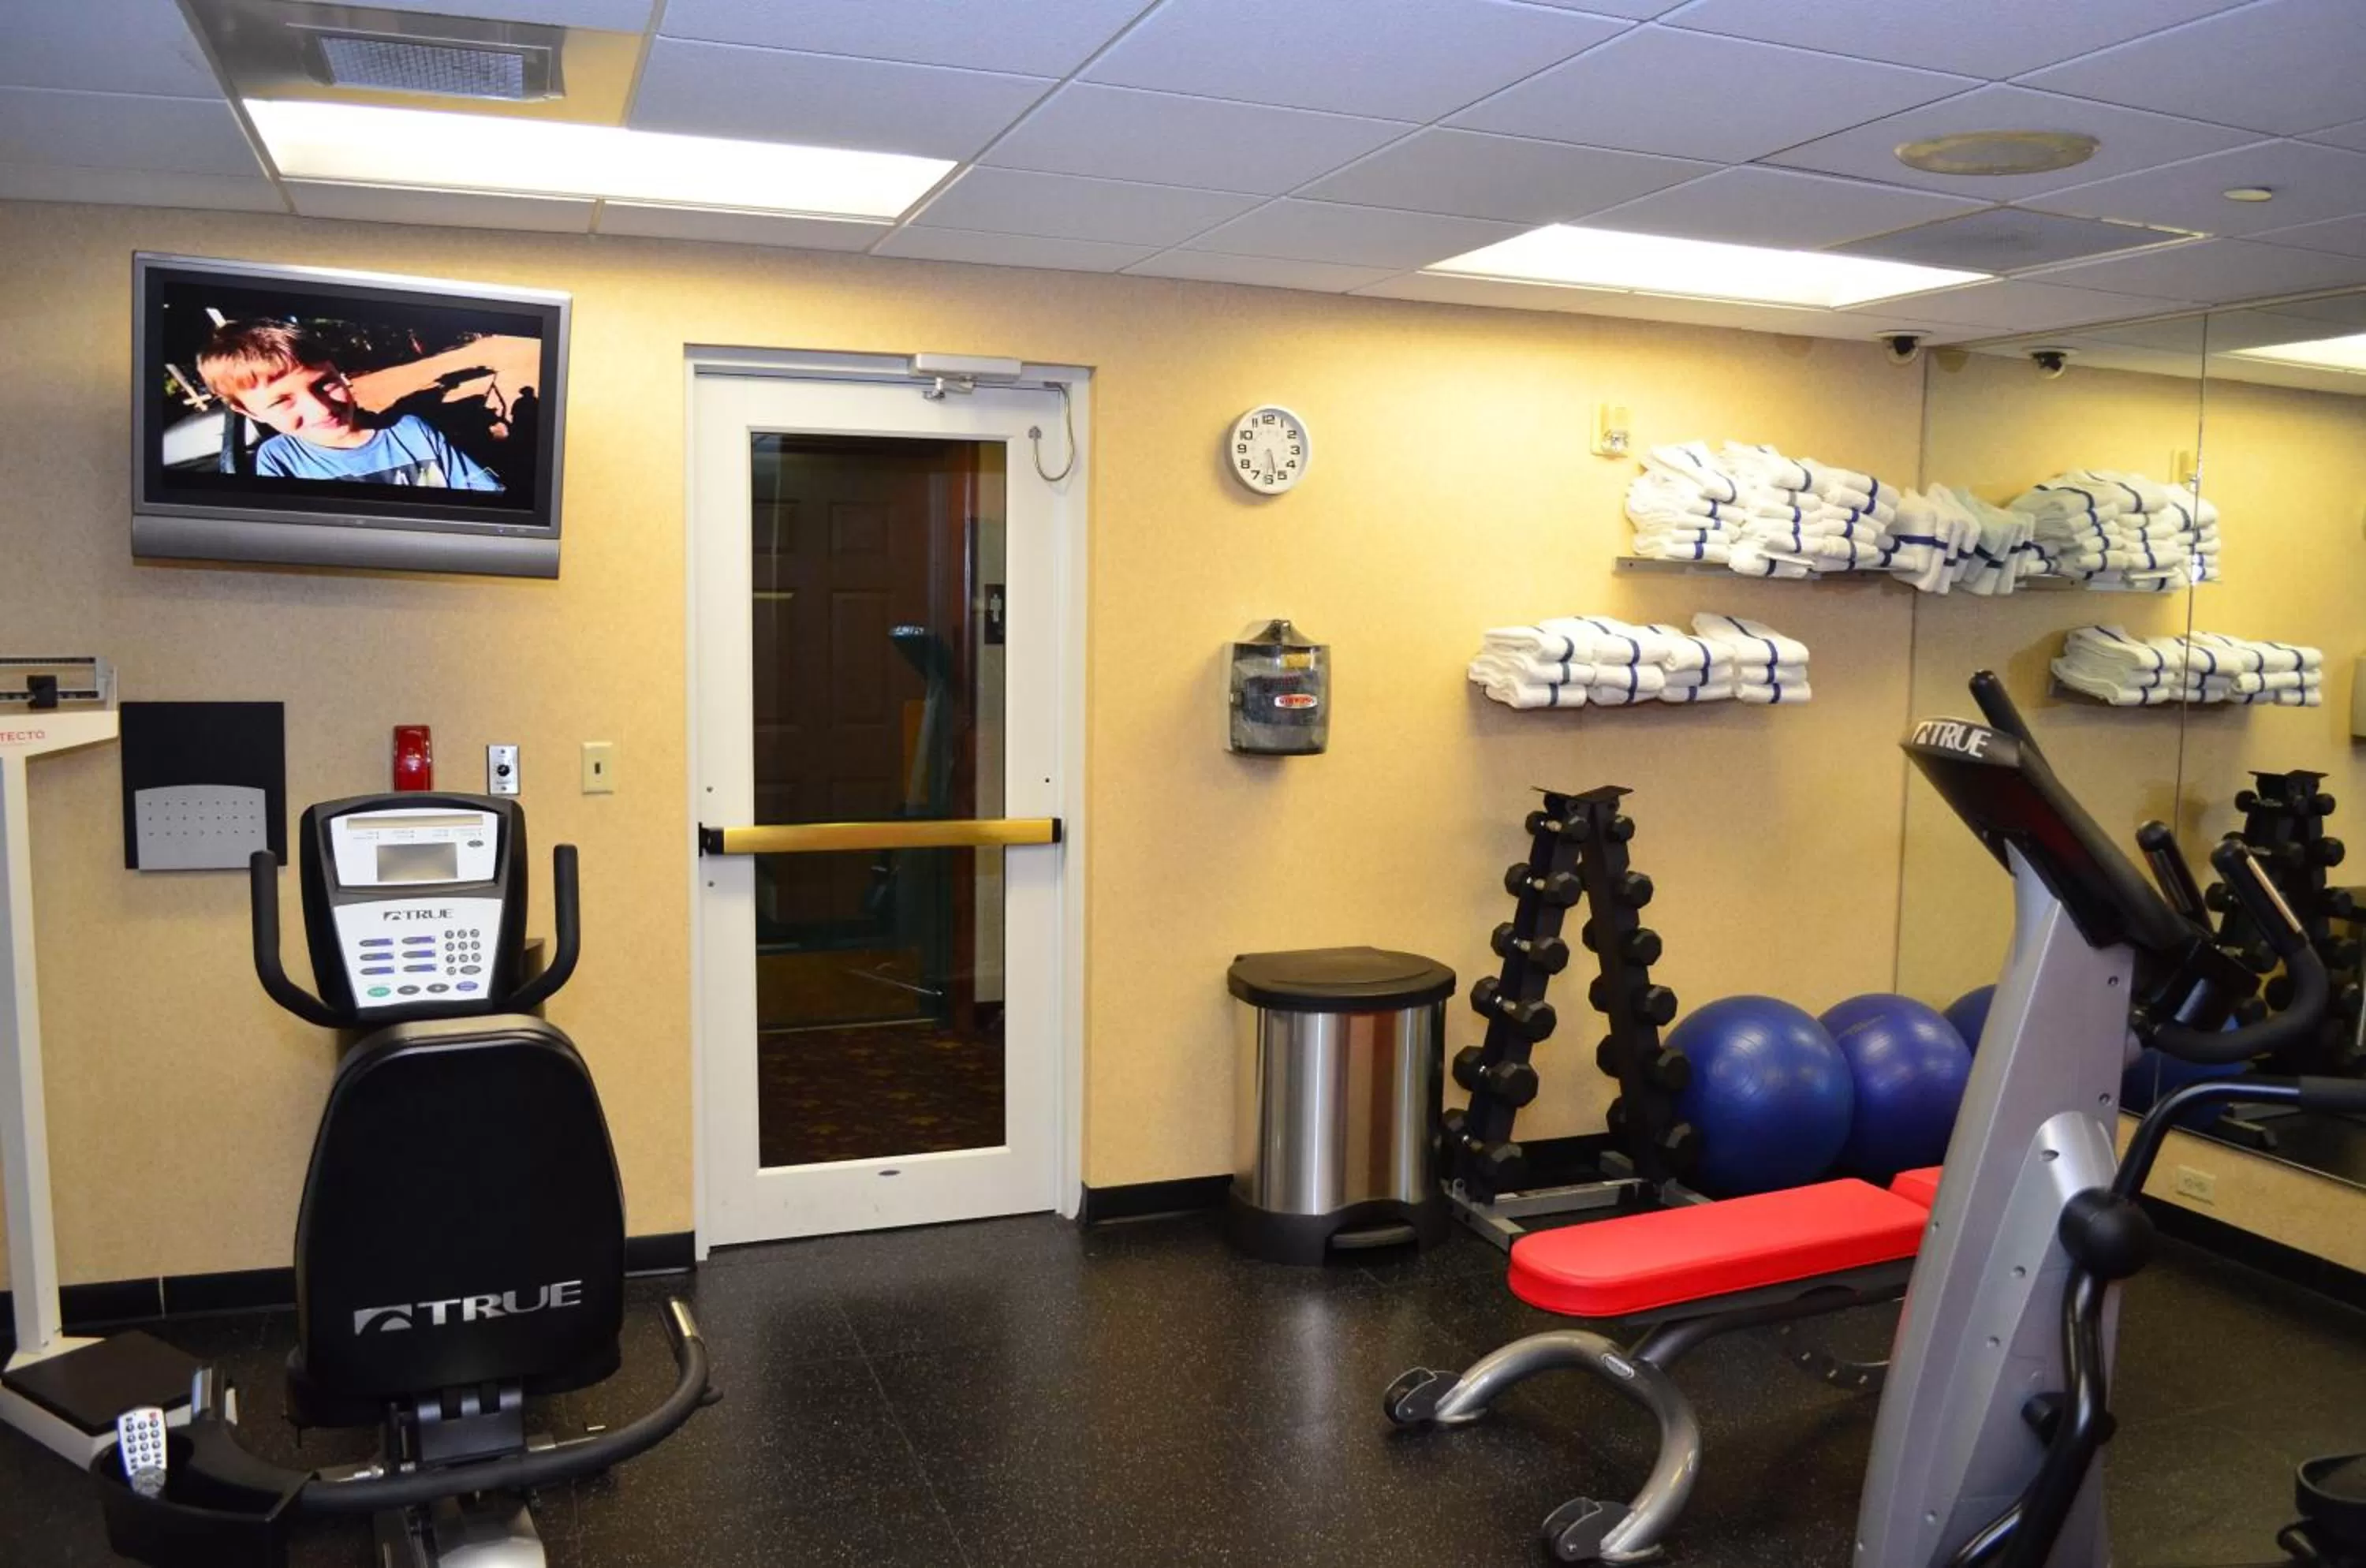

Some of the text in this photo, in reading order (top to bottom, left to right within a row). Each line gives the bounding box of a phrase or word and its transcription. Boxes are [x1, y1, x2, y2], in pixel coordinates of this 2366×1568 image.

[1252, 417, 1258, 428] 11
[1262, 414, 1275, 425] 12
[1239, 430, 1253, 440] 10
[1287, 430, 1297, 439] 2
[1237, 444, 1247, 454] 9
[1290, 445, 1301, 455] 3
[1241, 459, 1250, 469] 8
[1286, 460, 1296, 469] 4
[1251, 469, 1260, 480] 7
[1264, 474, 1274, 485] 6
[1278, 470, 1287, 480] 5
[1928, 722, 1992, 758] TRUE
[403, 908, 454, 920] TRUE
[417, 1279, 583, 1326] TRUE
